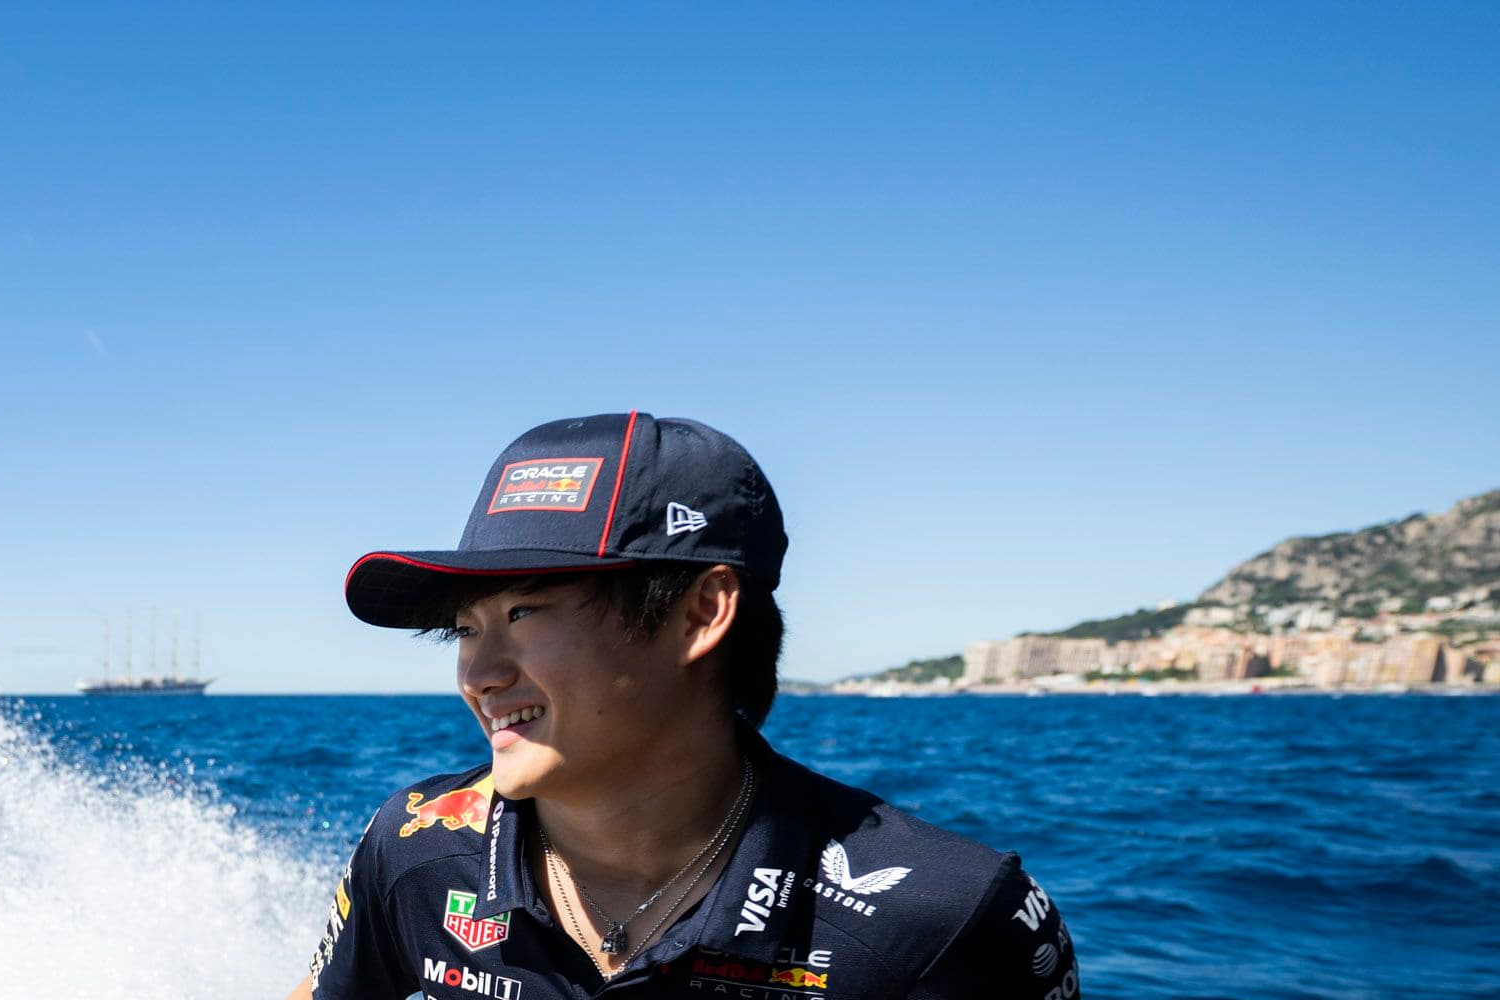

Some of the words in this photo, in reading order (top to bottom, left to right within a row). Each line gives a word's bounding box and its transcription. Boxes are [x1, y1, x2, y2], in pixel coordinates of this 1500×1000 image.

[510, 465, 588, 481] ORACLE
[500, 494, 577, 505] RACING
[487, 821, 501, 902] 1Password
[735, 867, 783, 937] VISA
[777, 871, 796, 908] Infinite
[803, 877, 877, 917] CASTORE
[1012, 876, 1051, 932] VIS
[449, 916, 506, 947] HEUER
[424, 957, 492, 997] Mobil
